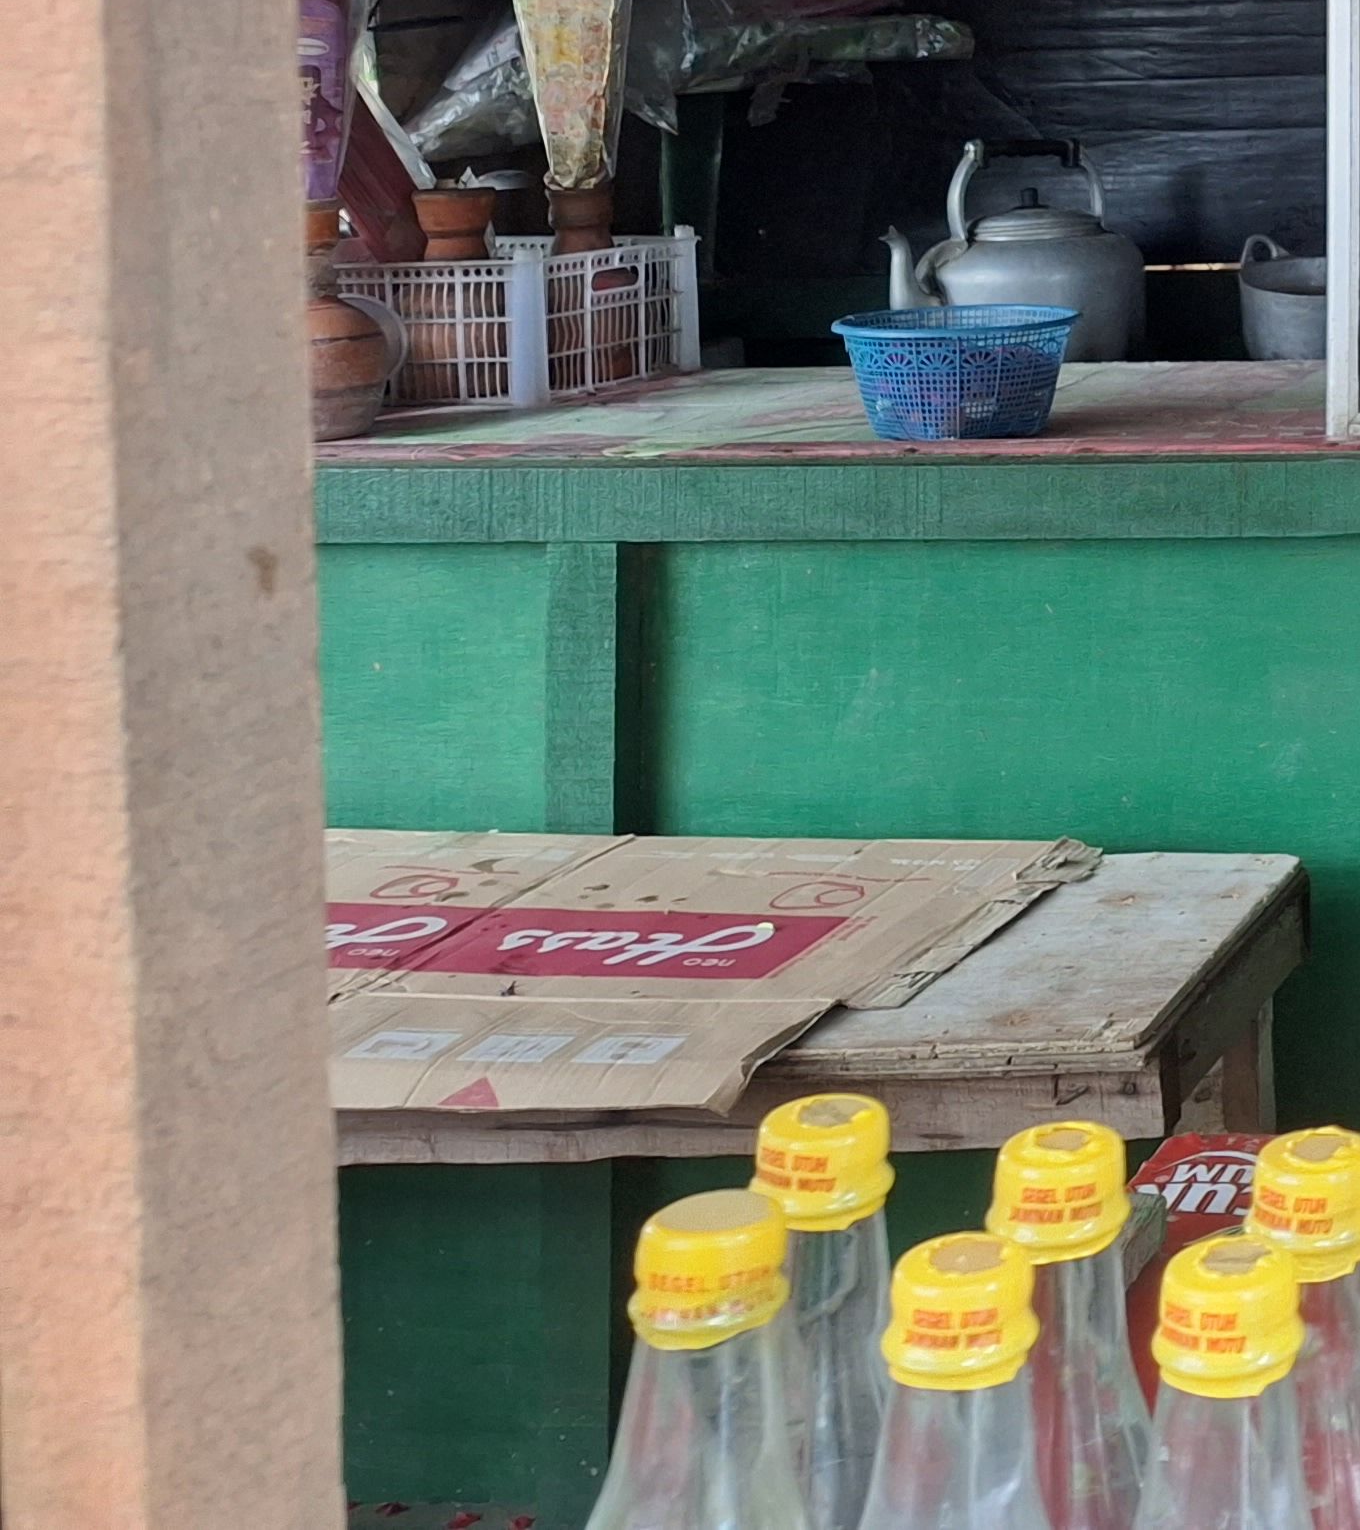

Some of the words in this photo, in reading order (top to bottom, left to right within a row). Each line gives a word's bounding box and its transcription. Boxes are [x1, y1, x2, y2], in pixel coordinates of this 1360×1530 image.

[498, 925, 776, 967] Hass
[683, 957, 738, 968] neo
[649, 1272, 711, 1293] SEGEL
